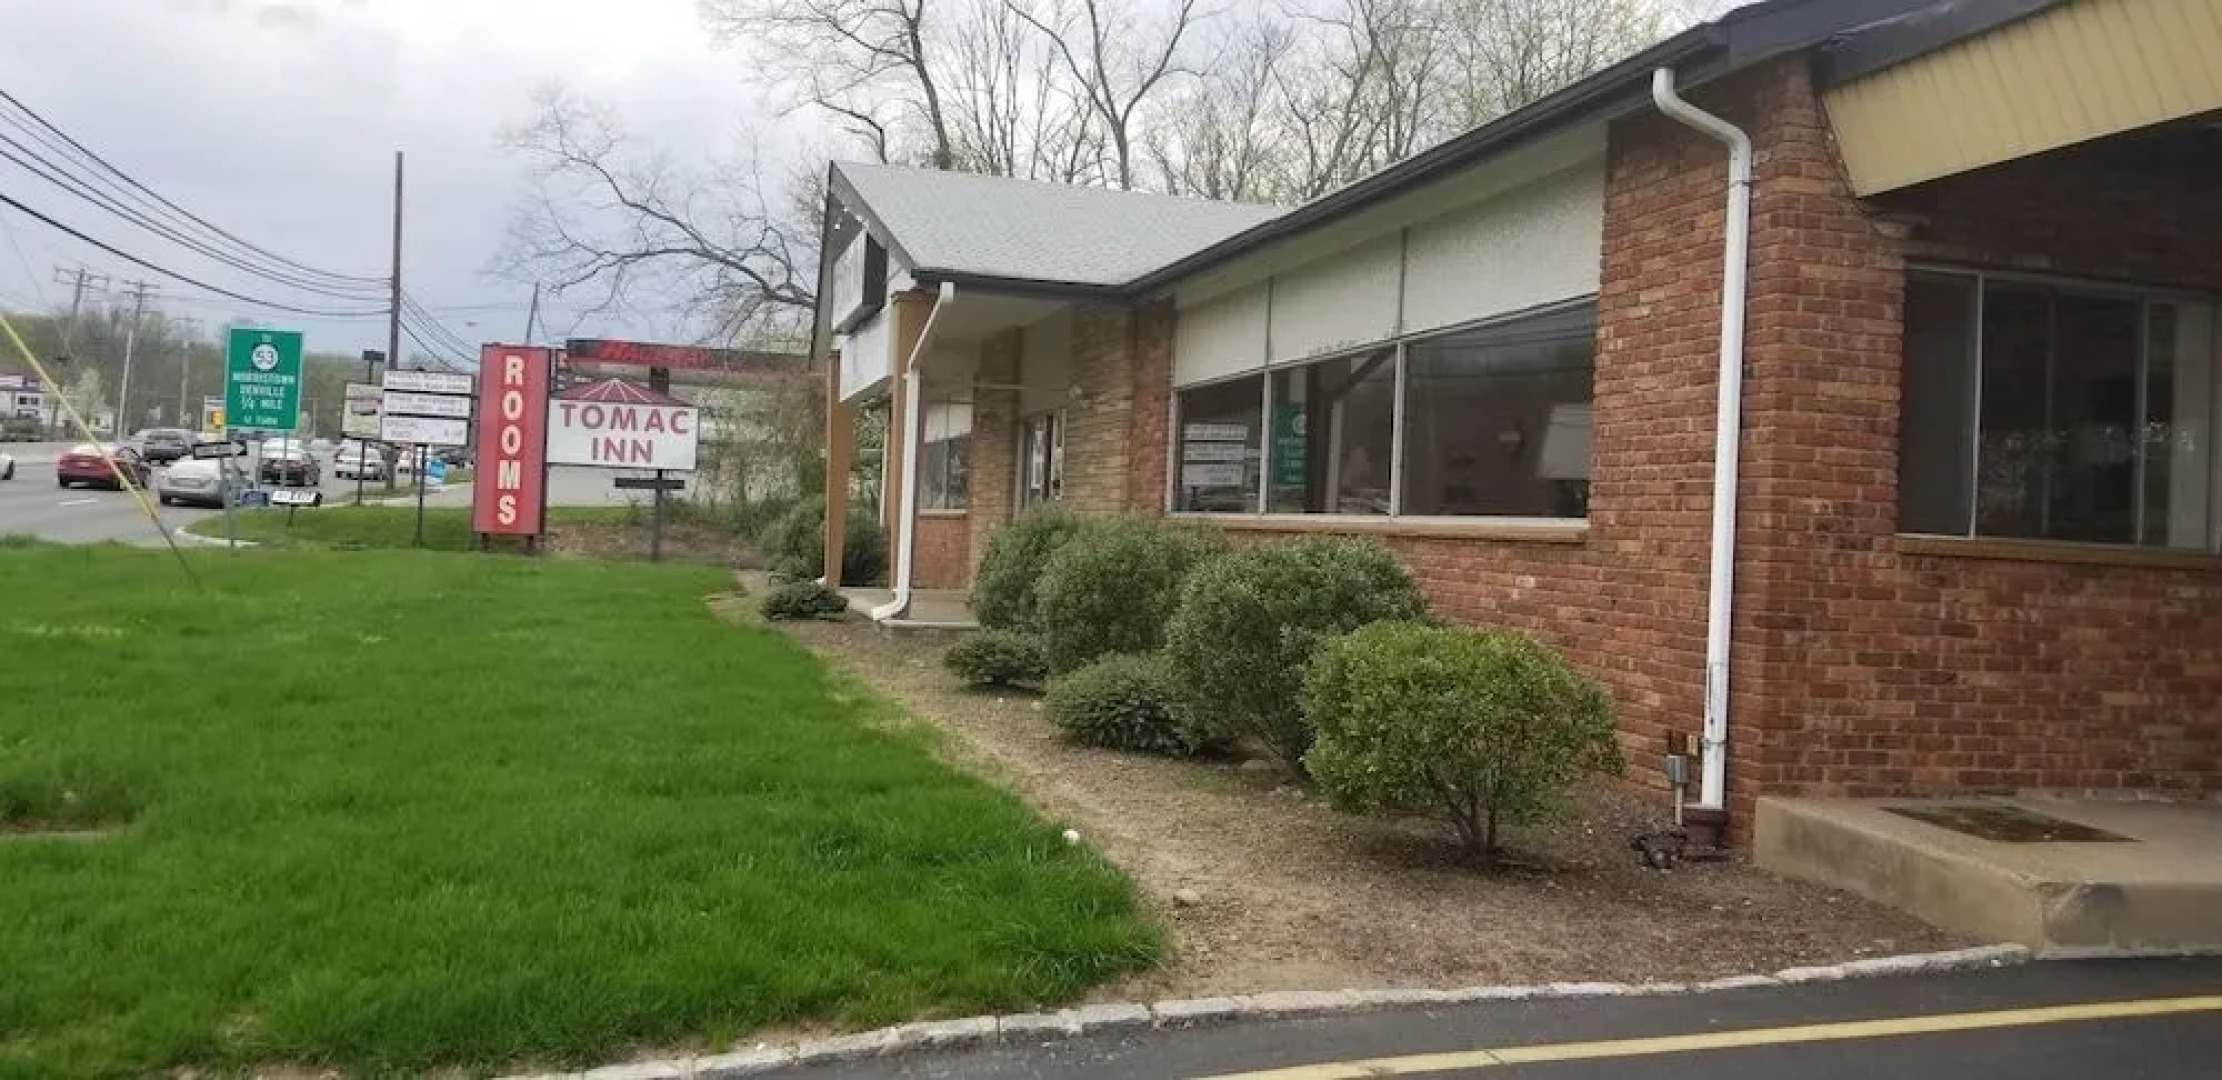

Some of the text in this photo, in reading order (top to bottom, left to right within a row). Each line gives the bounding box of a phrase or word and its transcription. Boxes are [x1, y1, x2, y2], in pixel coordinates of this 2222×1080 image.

[255, 350, 275, 365] 53
[232, 372, 295, 385] MORRISTOWN
[559, 404, 690, 434] TOMAC
[498, 355, 524, 525] ROOMS
[590, 437, 654, 464] INN
